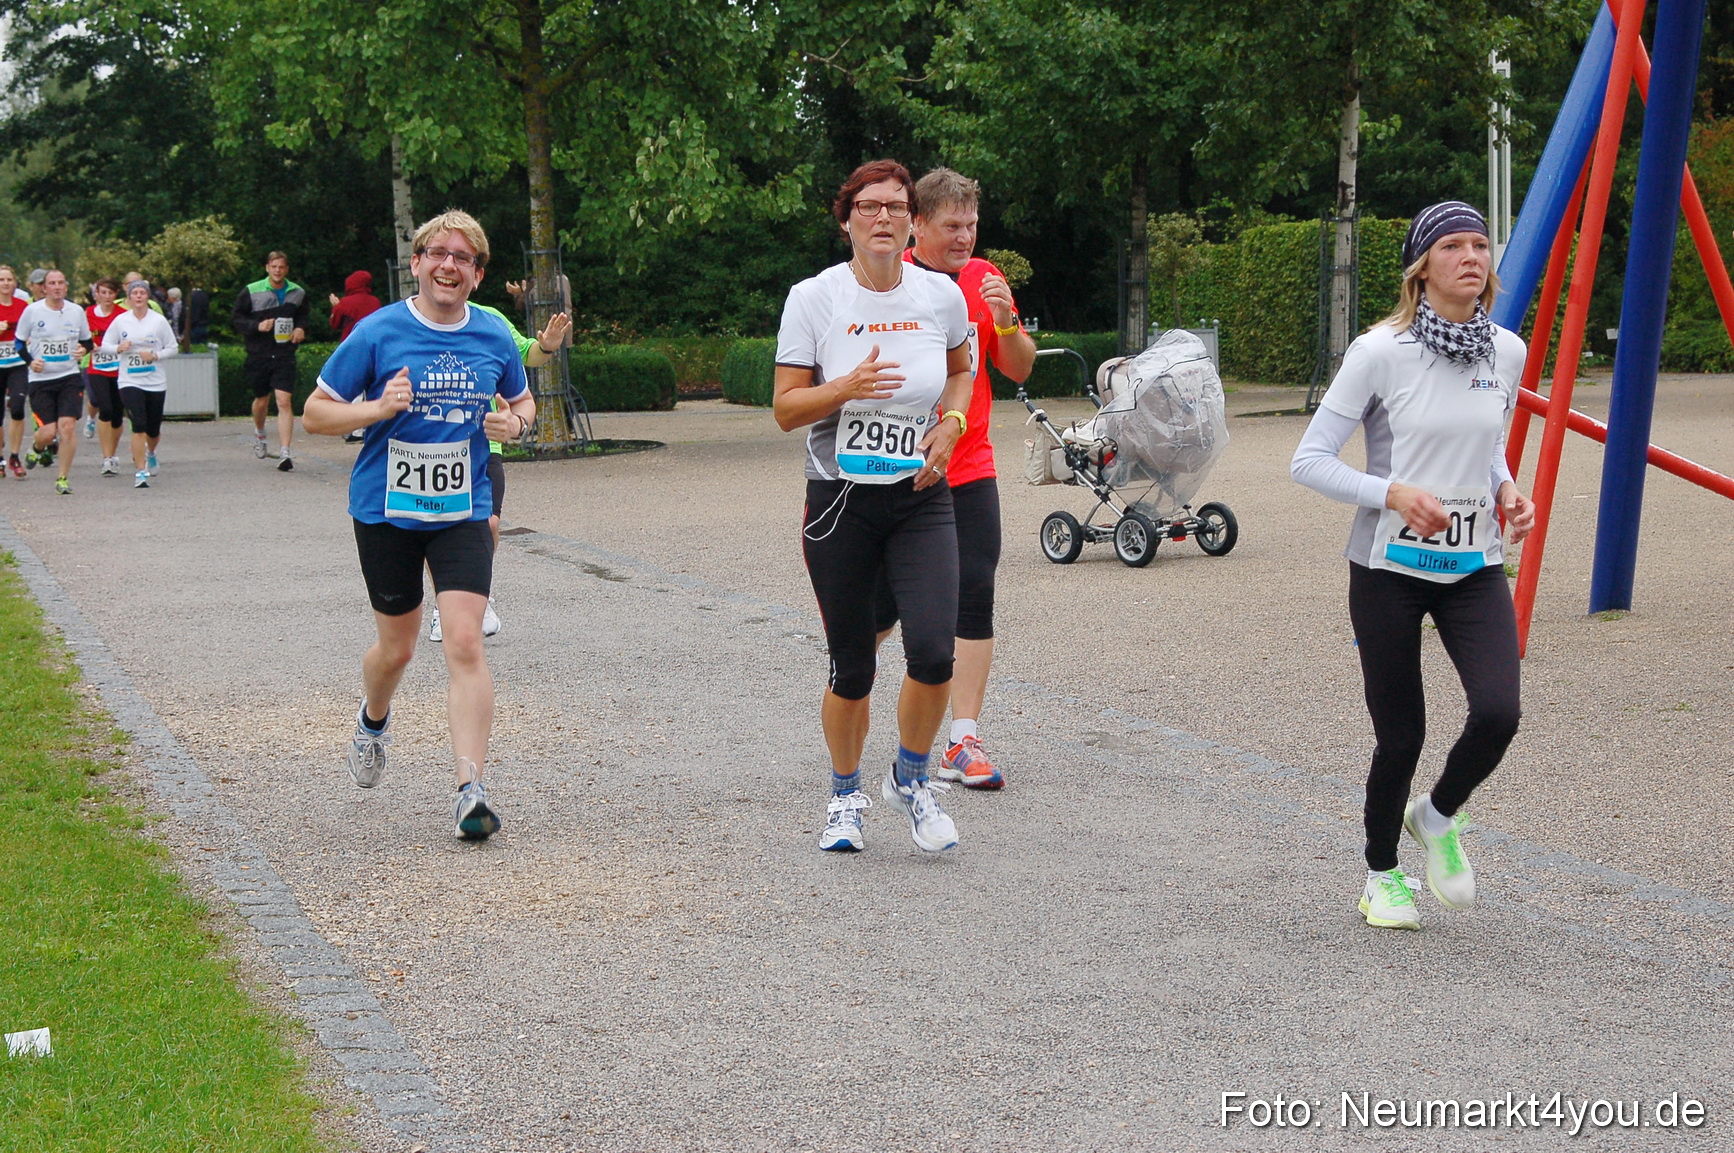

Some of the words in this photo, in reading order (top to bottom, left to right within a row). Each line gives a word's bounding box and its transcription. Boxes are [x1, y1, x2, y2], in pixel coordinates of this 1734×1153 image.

[868, 321, 924, 333] KLEBL
[874, 410, 914, 422] Neumarkt
[846, 419, 916, 457] 2950
[390, 446, 416, 459] PARTL
[418, 451, 459, 460] Neumarkt
[866, 459, 898, 472] Petra
[396, 461, 465, 492] 2169
[415, 498, 446, 511] Peter
[1417, 553, 1458, 570] Ulrike
